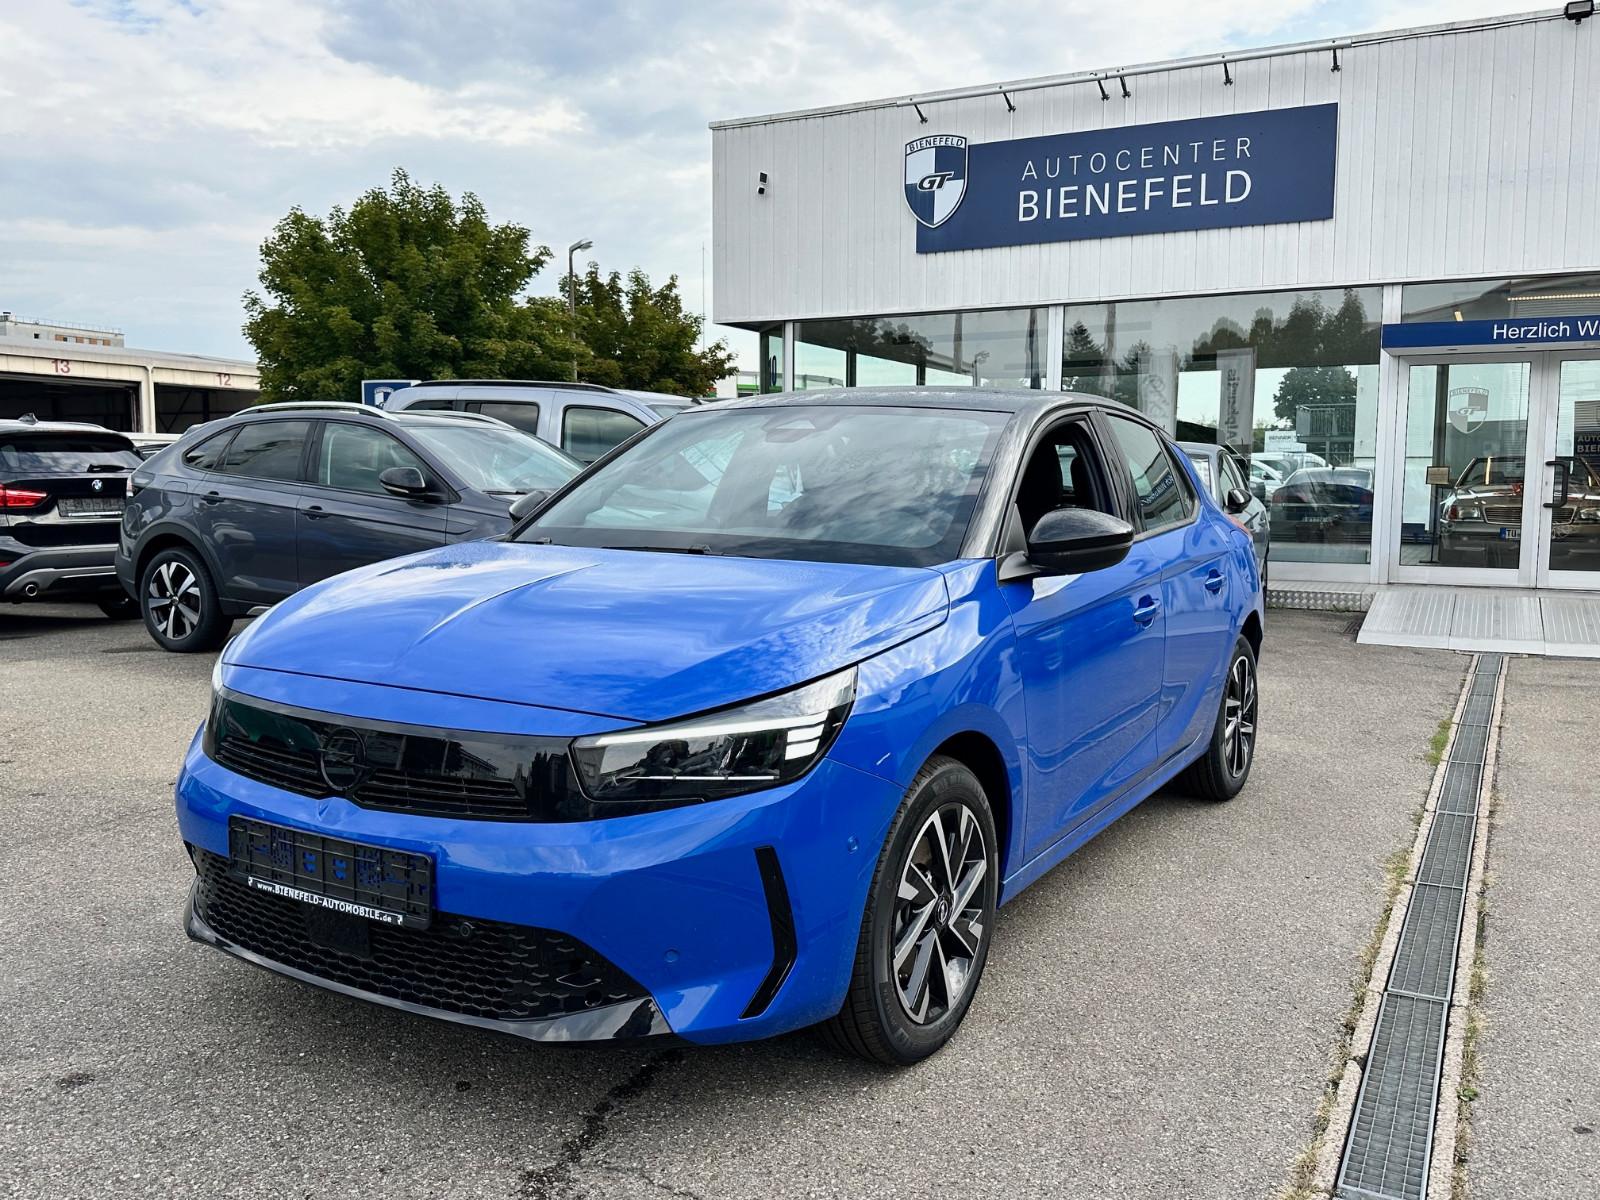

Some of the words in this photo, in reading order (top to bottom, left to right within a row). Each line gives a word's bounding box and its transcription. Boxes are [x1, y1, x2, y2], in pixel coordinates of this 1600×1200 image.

[908, 137, 964, 152] BIENEFELD
[1021, 137, 1252, 181] AUTOCENTER
[917, 171, 955, 191] GT
[1018, 169, 1252, 223] BIENEFELD
[1492, 321, 1570, 340] Herzlich
[1577, 319, 1600, 337] W
[51, 359, 71, 374] 13
[215, 373, 232, 386] 12
[256, 883, 392, 923] www.BIENEFELD-AUTOMOBILE.de
